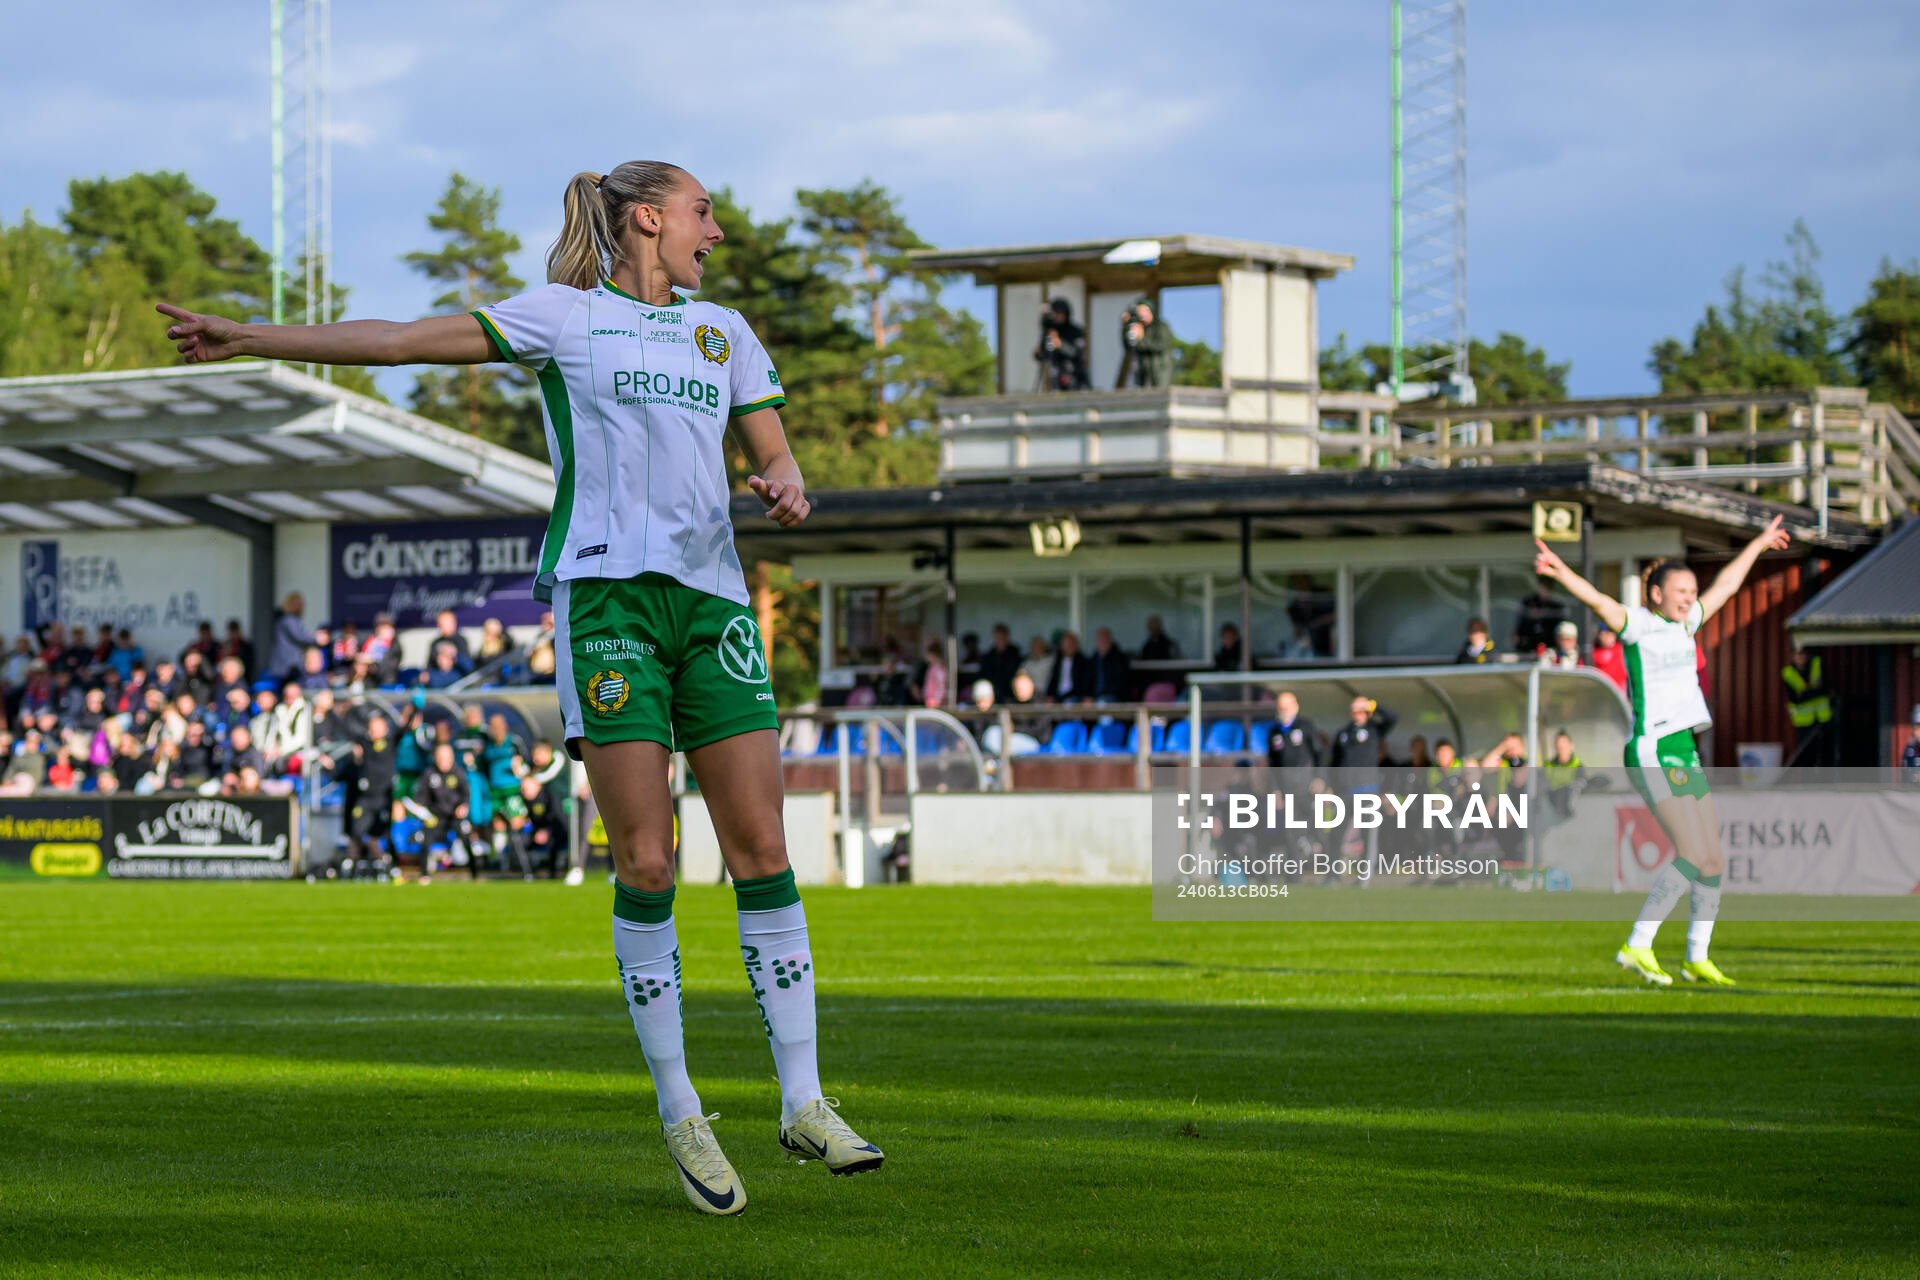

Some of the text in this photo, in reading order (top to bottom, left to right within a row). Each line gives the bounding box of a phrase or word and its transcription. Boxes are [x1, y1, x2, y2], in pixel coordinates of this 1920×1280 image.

[656, 310, 682, 319] INTER
[658, 317, 682, 325] SPORT
[644, 336, 689, 344] WELLNESS
[613, 370, 720, 409] PROJOB
[616, 396, 718, 419] PROFESSIONAL WORKWEAR
[343, 533, 538, 579] GÖINGE BIL
[166, 799, 263, 845] CORTINA
[1719, 821, 1832, 849] ENSKA
[1728, 857, 1762, 882] EL
